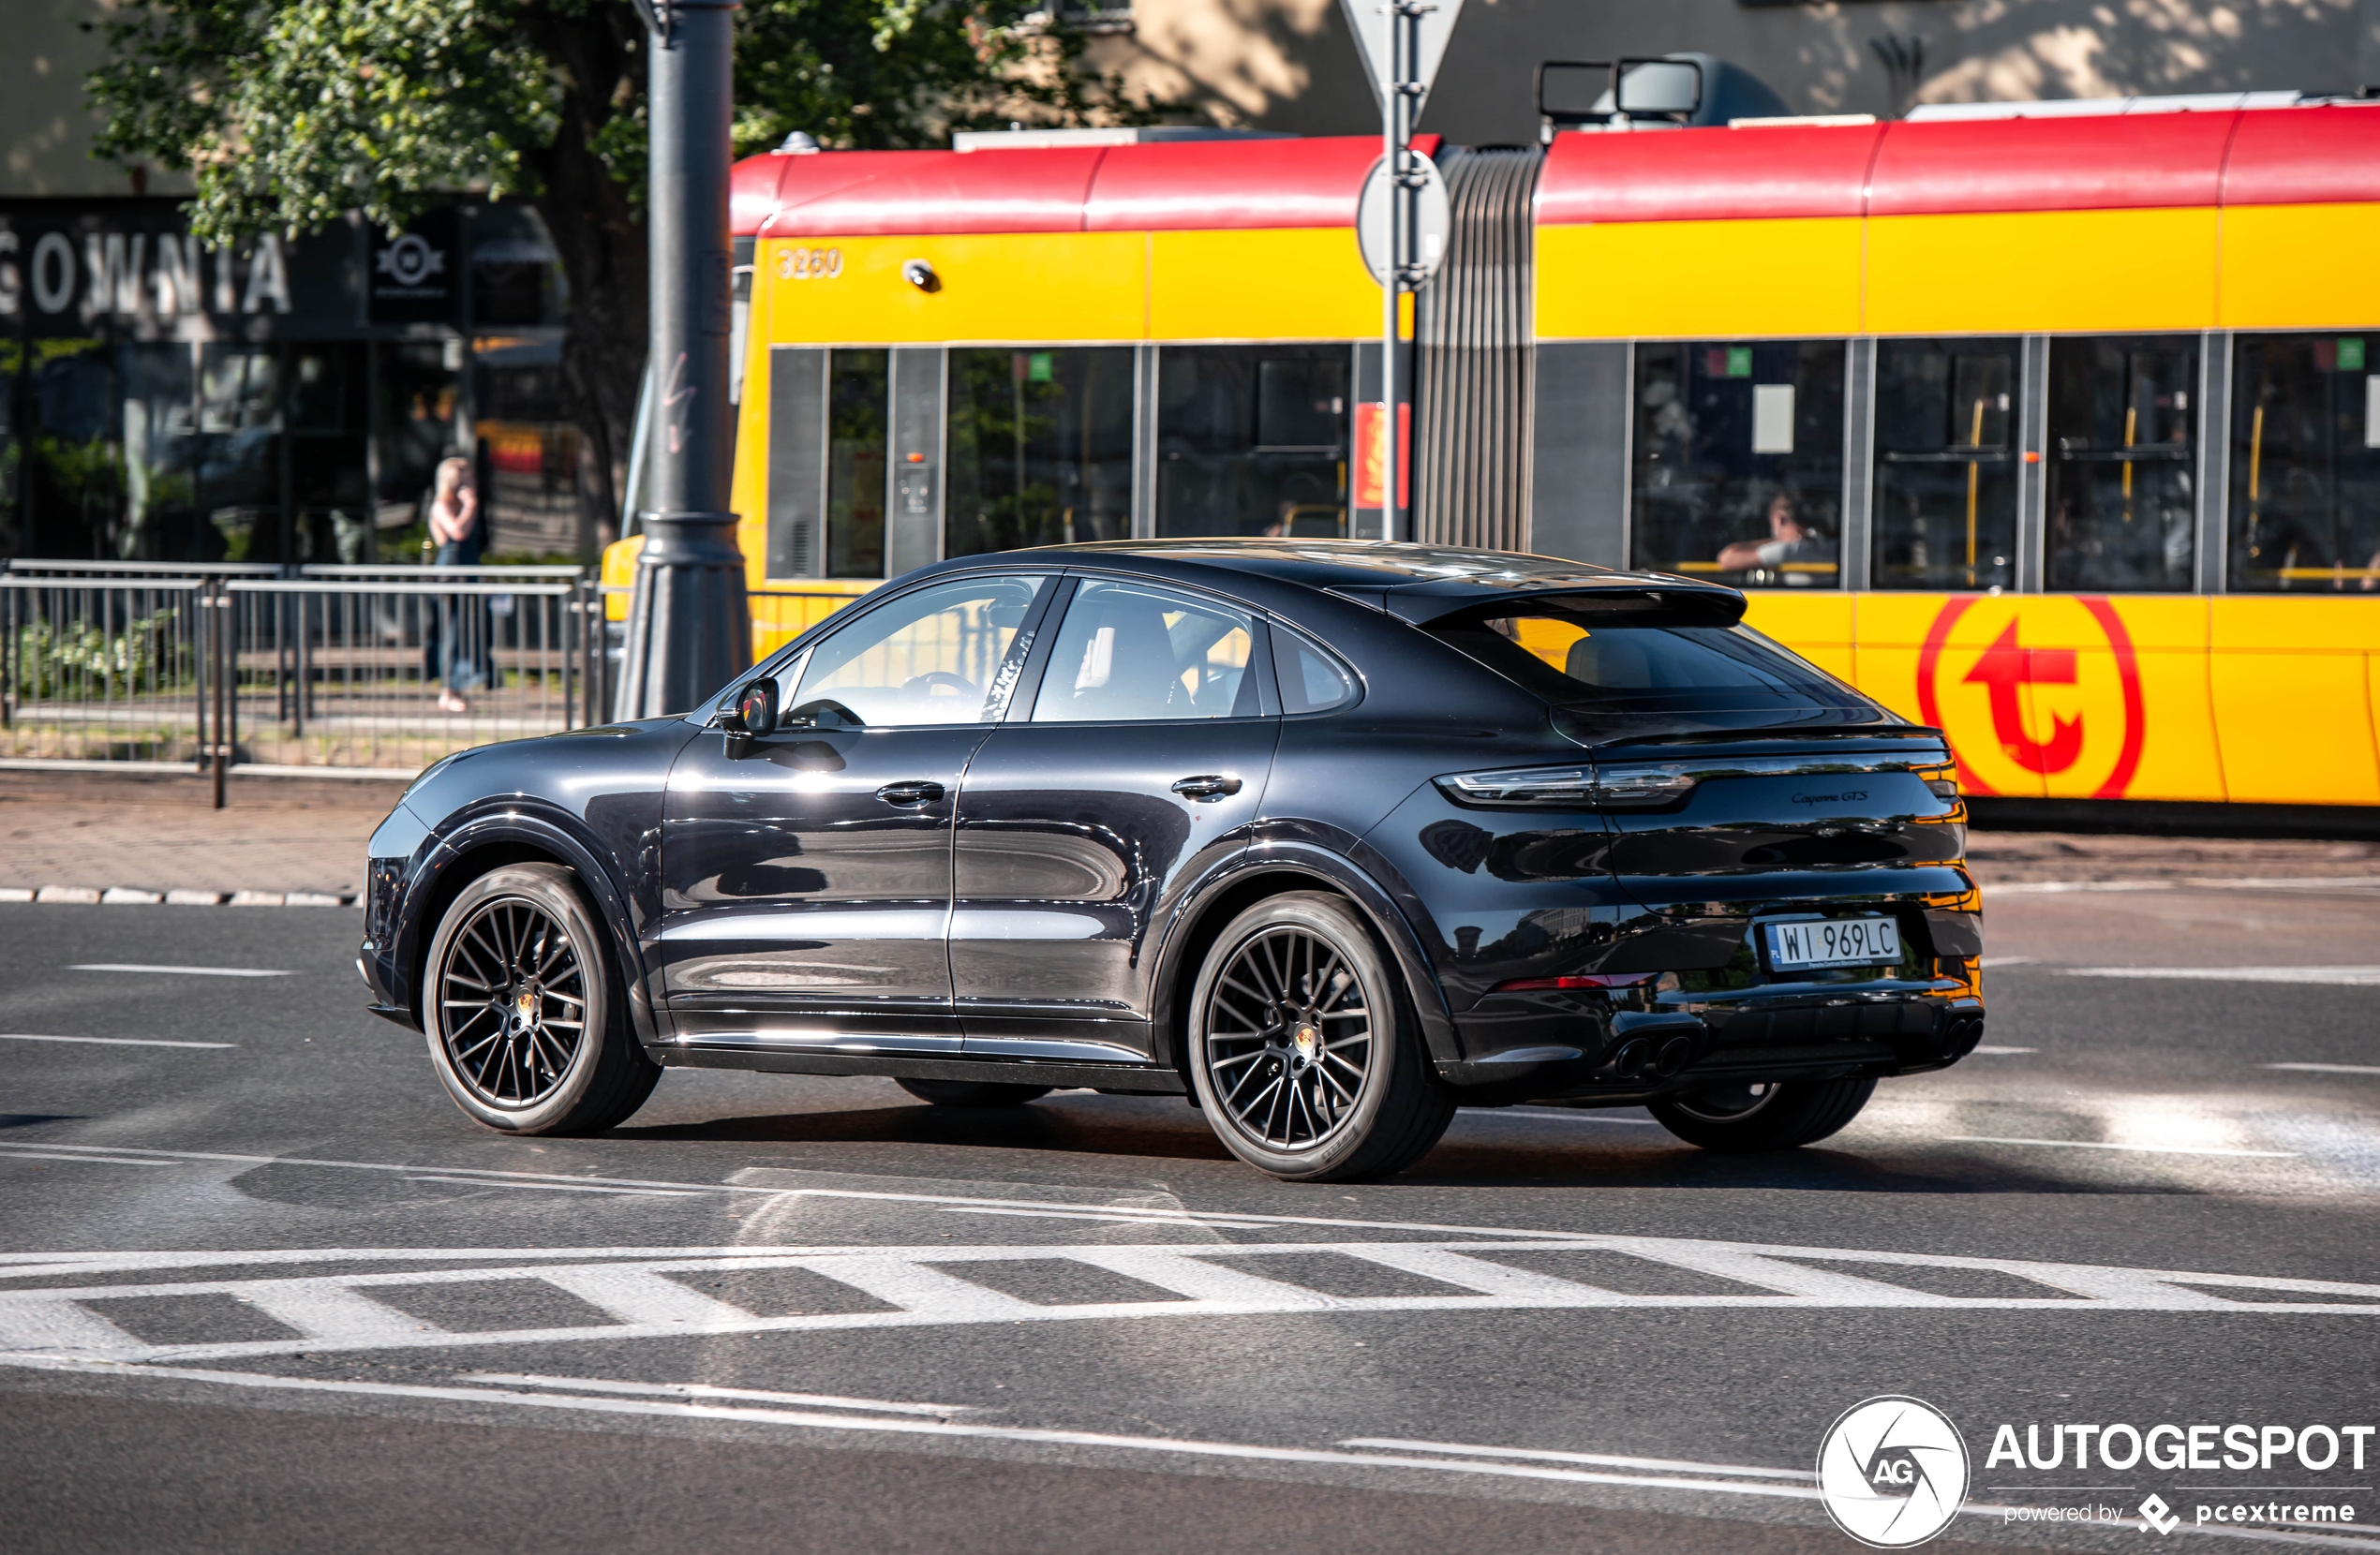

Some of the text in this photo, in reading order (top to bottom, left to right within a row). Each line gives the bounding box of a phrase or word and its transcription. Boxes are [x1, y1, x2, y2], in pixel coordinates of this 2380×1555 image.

[777, 247, 844, 280] 3260
[1792, 791, 1868, 807] Cayenne GTS
[1783, 923, 1894, 960] WI 969LC
